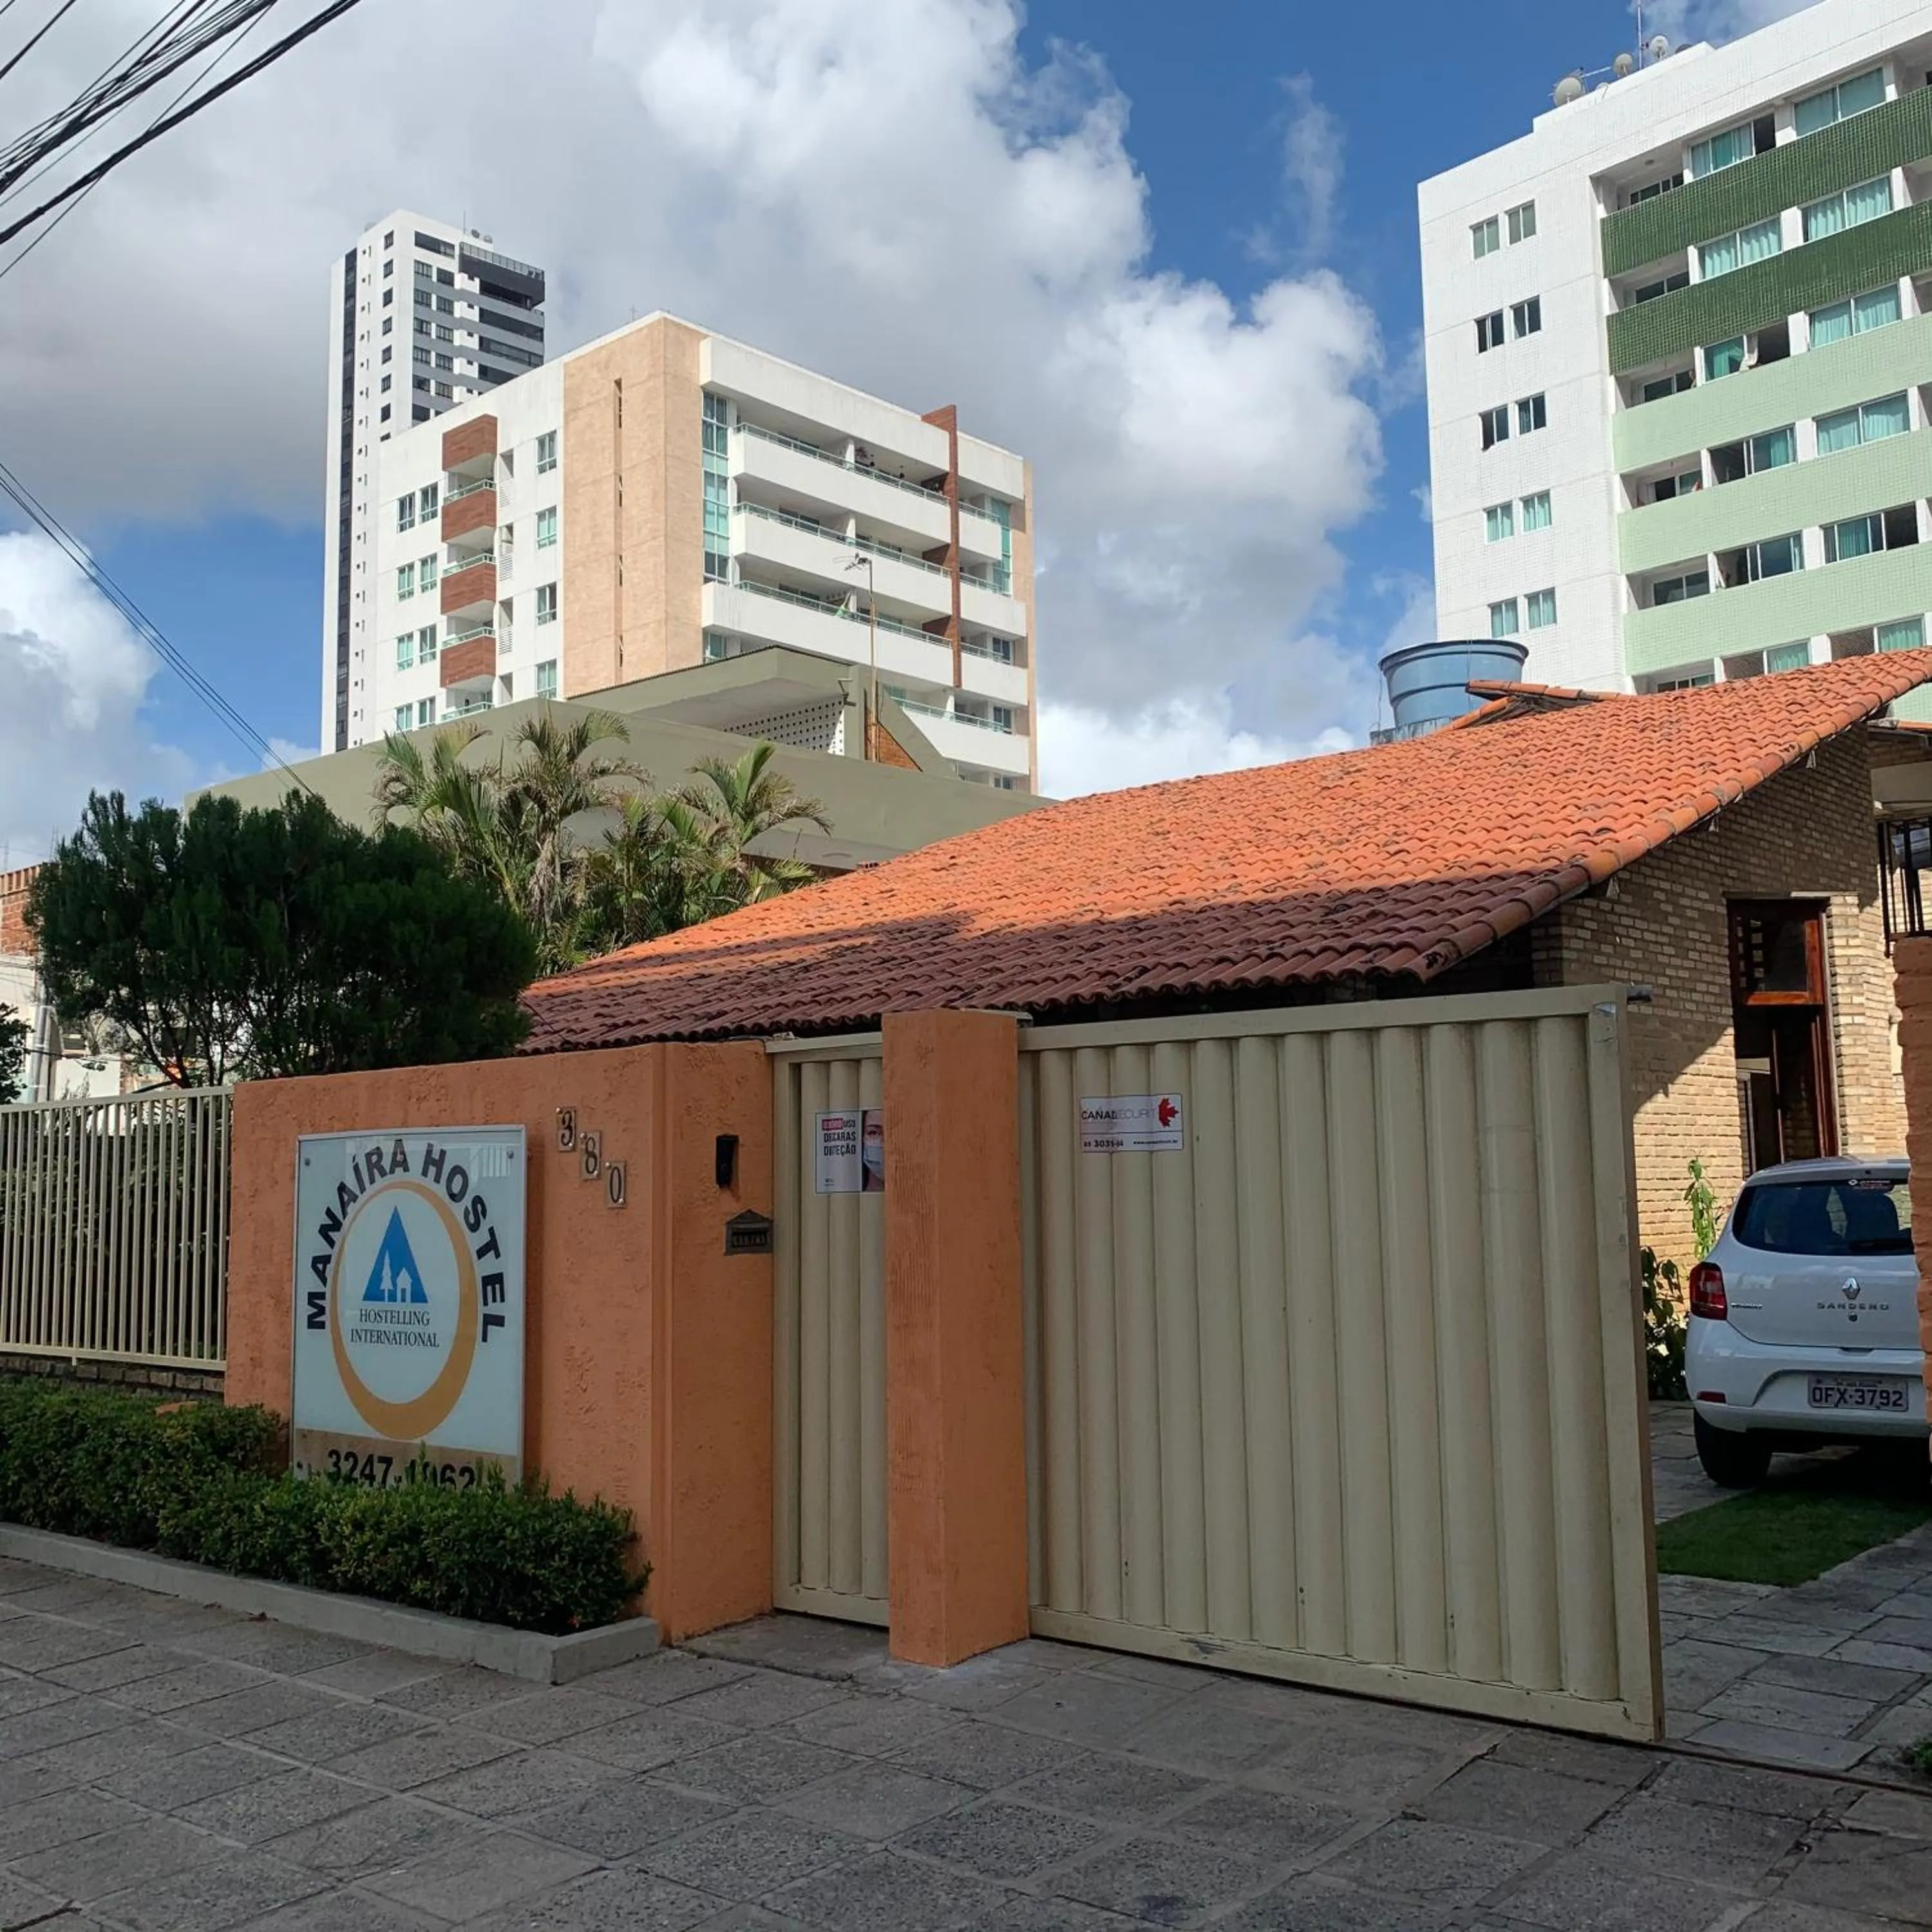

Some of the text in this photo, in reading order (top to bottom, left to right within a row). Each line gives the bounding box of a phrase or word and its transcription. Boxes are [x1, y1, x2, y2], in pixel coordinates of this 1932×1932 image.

[307, 1139, 505, 1343] MANAÍRA HOSTEL
[359, 1308, 430, 1327] HOSTELLING
[350, 1329, 440, 1348] INTERNATIONAL
